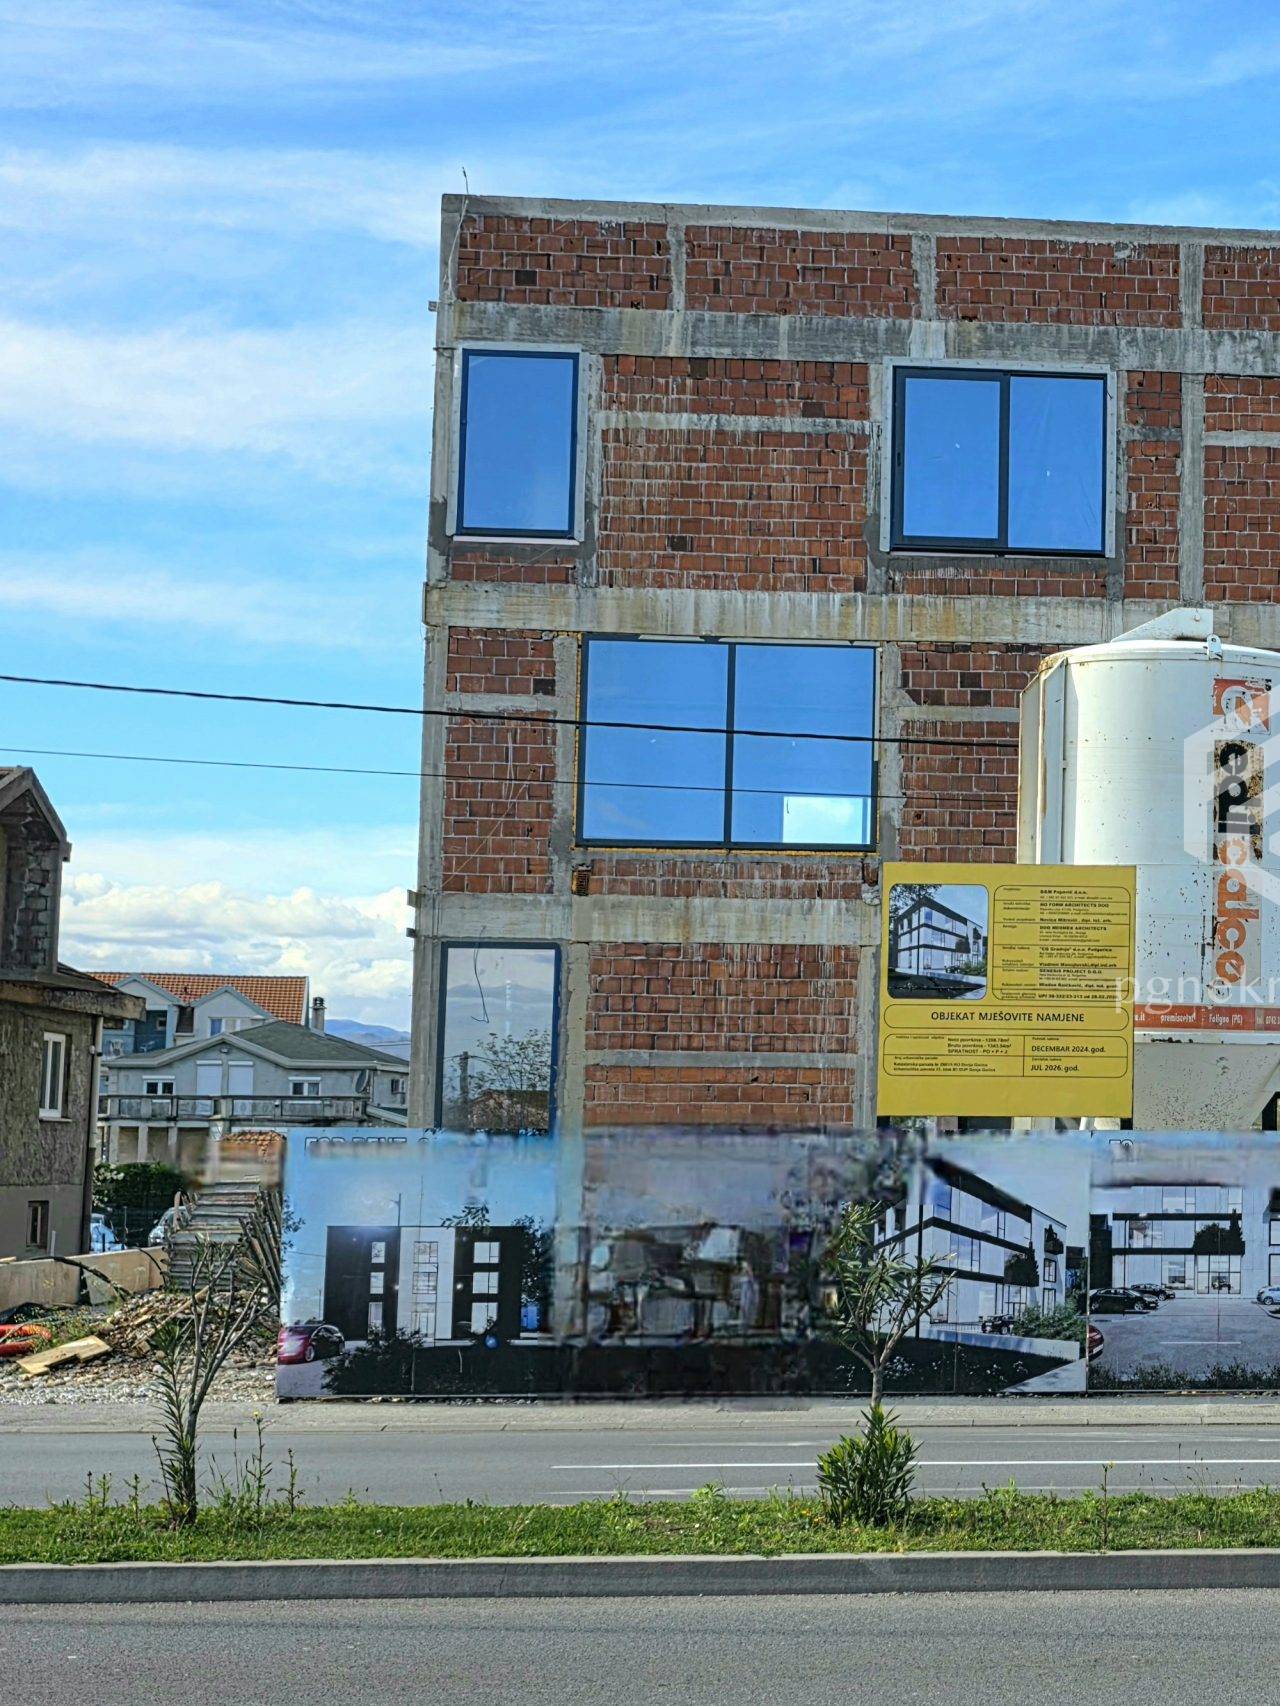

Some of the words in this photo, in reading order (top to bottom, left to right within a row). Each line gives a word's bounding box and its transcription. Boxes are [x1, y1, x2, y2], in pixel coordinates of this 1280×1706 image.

[931, 1011, 976, 1021] OBJEKAT
[979, 1010, 1033, 1022] MJEŠOVITE
[1036, 1012, 1085, 1022] NAMJENE
[1031, 1044, 1071, 1052] DECEMBAR
[1031, 1064, 1043, 1072] JUL
